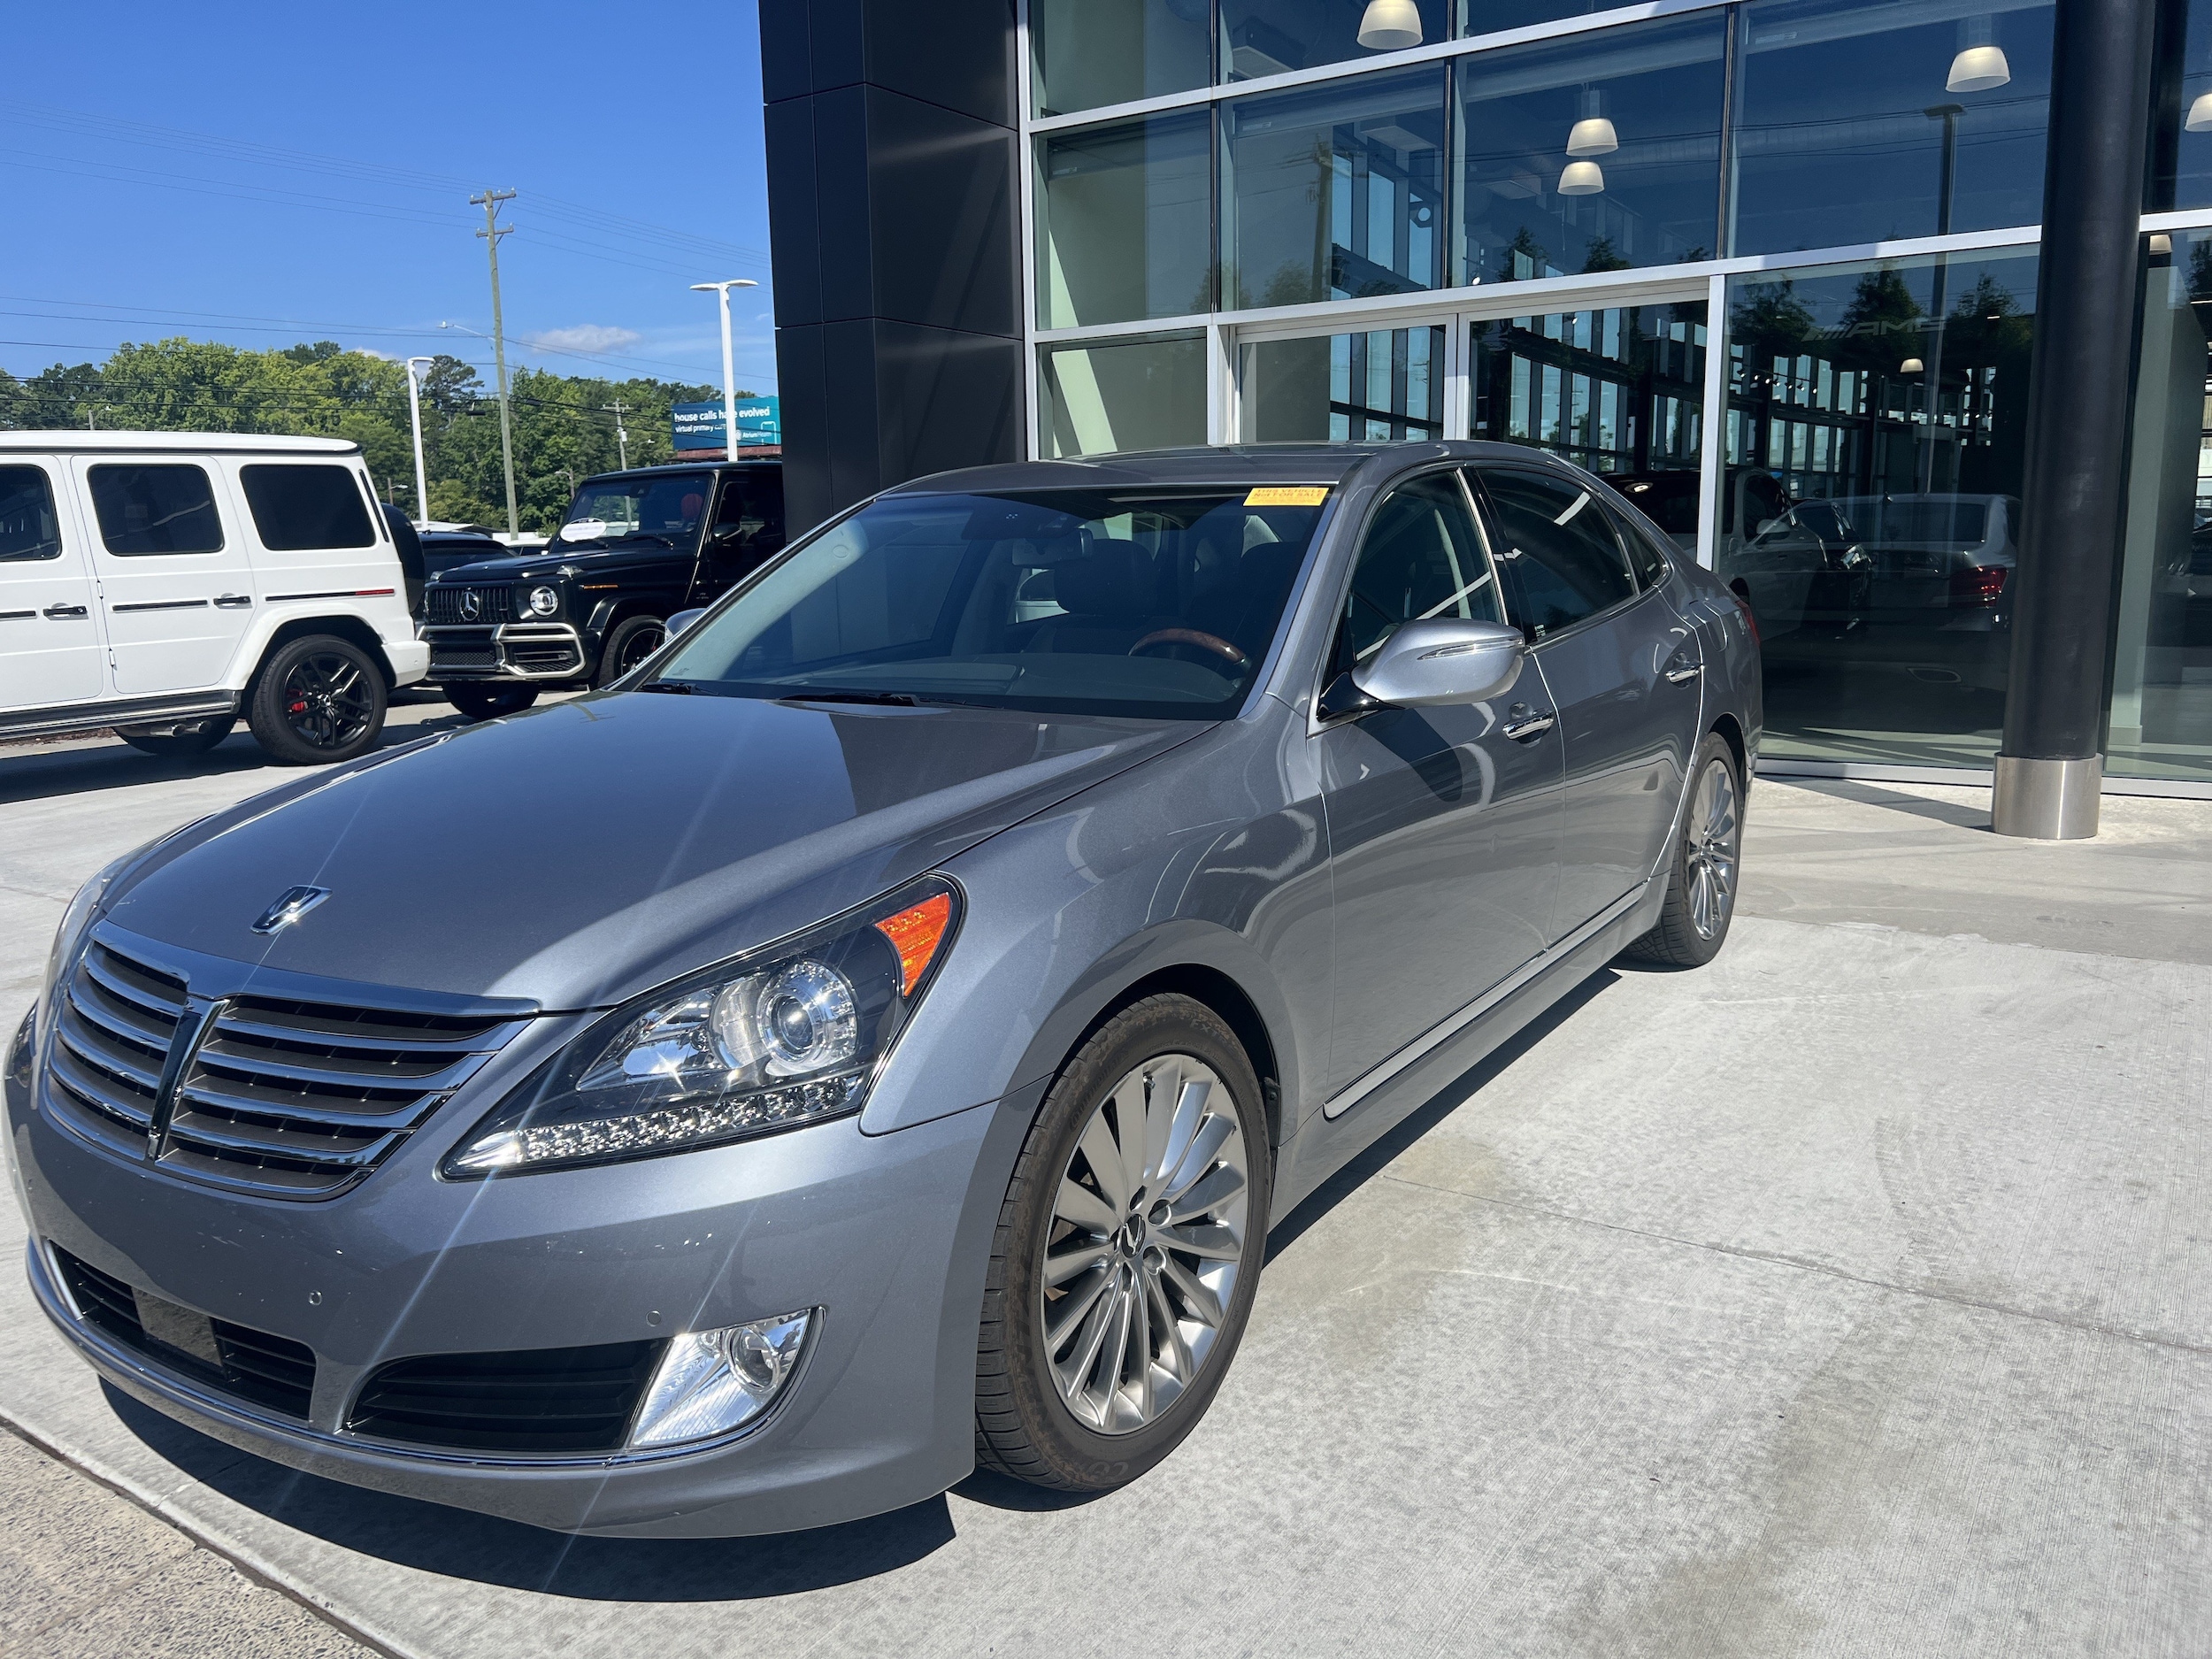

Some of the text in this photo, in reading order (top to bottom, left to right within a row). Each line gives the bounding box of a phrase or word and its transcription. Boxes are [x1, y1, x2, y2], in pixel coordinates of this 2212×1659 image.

[674, 413, 698, 422] house
[700, 410, 718, 421] calls
[739, 406, 771, 419] evolved
[693, 425, 714, 434] primary
